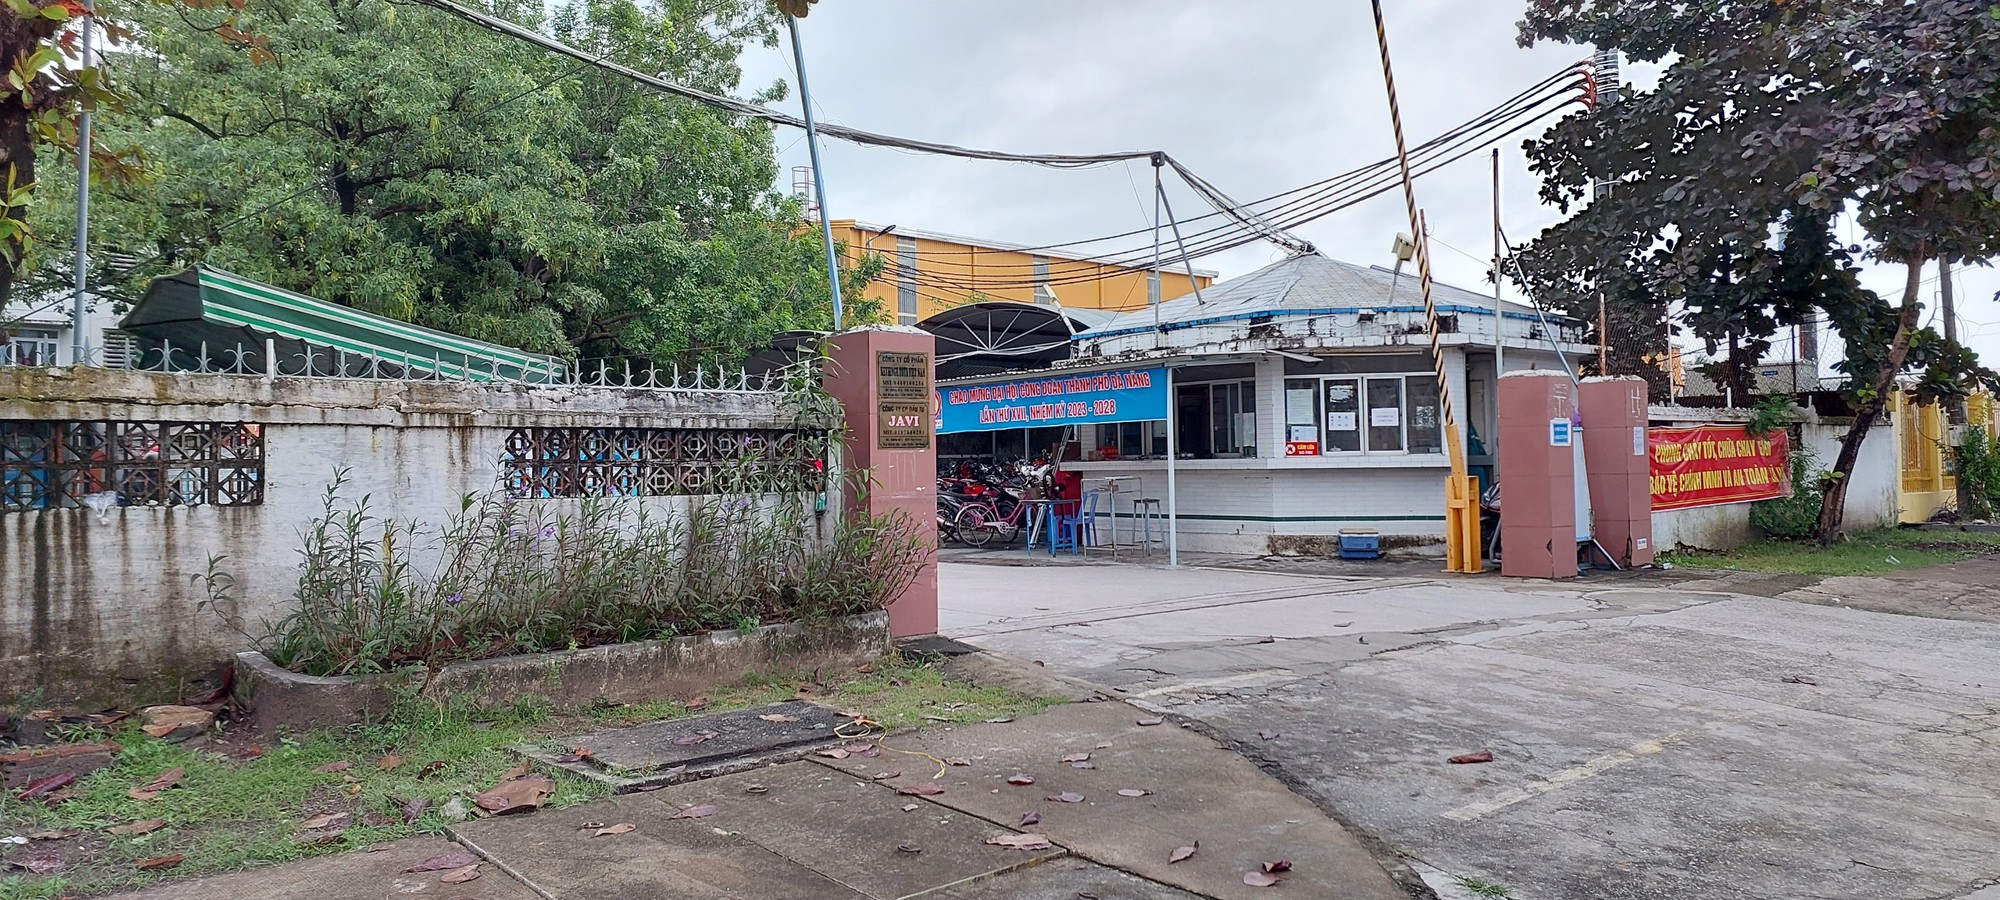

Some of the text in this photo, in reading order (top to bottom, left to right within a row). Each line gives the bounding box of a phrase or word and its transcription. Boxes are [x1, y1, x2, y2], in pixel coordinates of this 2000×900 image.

[949, 387, 969, 405] CHÀO
[969, 385, 991, 403] MỪNG
[992, 385, 1005, 402] ĐẠI
[1006, 382, 1018, 402] HỘI
[1019, 380, 1041, 397] CÔNG
[1042, 378, 1064, 396] ĐOÀN
[1065, 376, 1091, 394] THÀNH
[1092, 372, 1110, 391] PHỐ
[1110, 372, 1125, 390] ĐÀ
[889, 415, 919, 427] JAVI
[980, 405, 996, 424] LẦN
[996, 404, 1011, 423] THỨ
[1011, 406, 1029, 422] XVII,
[1029, 402, 1054, 422] NHIỆM
[1055, 400, 1066, 418] KỲ
[1067, 401, 1087, 417] 2023
[1093, 399, 1116, 416] 2028
[1655, 440, 1682, 463] PHÒNG
[1682, 439, 1701, 461] CHÁY
[1702, 435, 1718, 460] TỐT,
[1717, 437, 1736, 458] CHỮA
[1649, 469, 1666, 495] BẢO
[1667, 470, 1677, 497] VỆ
[1680, 469, 1702, 492] CHÍNH
[1702, 467, 1723, 489] MÌNH
[1722, 466, 1733, 487] VÀ
[1733, 468, 1745, 487] AN
[1744, 464, 1769, 485] TOÀN
